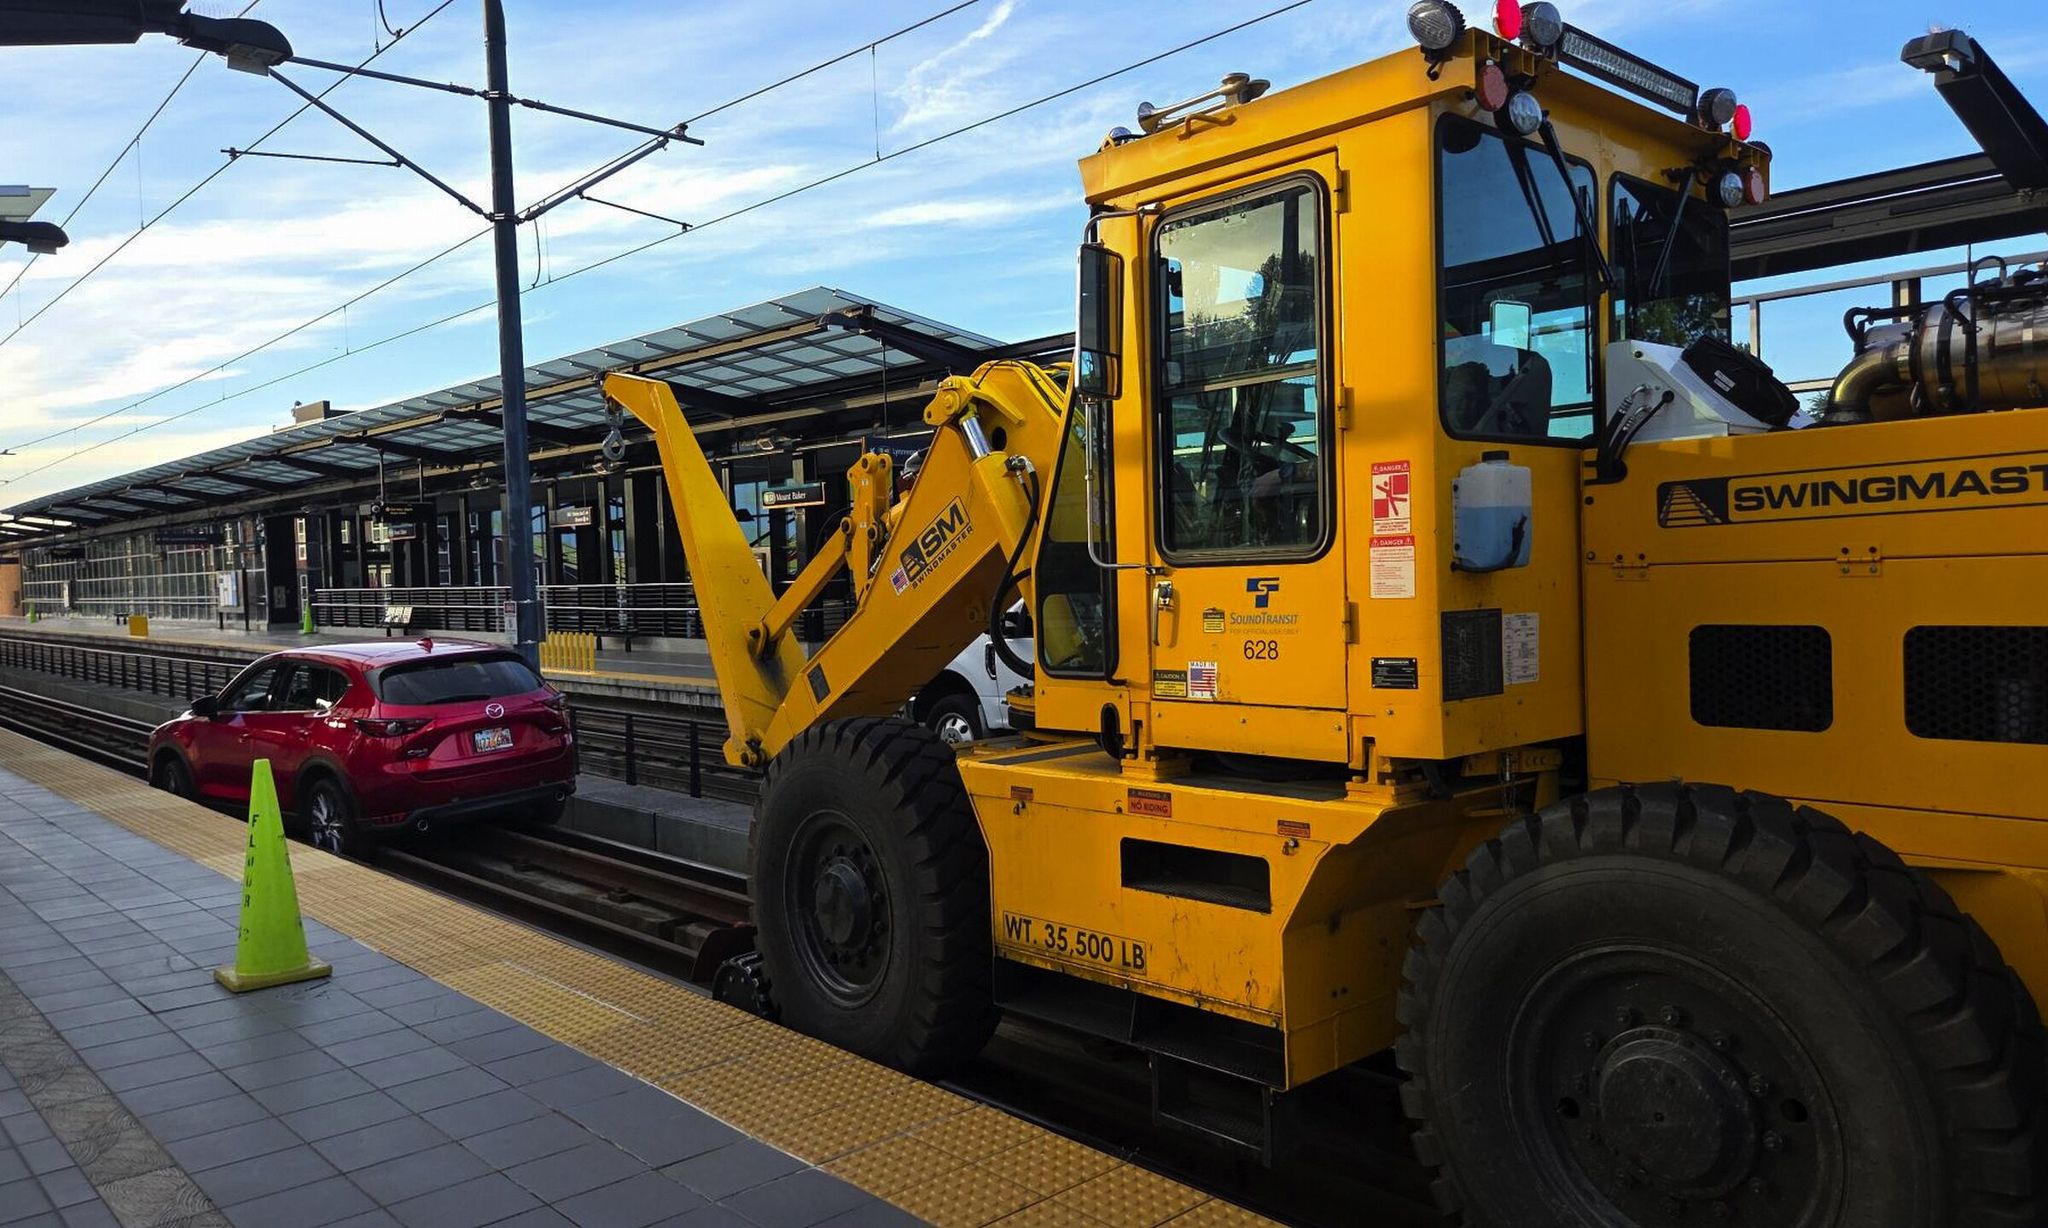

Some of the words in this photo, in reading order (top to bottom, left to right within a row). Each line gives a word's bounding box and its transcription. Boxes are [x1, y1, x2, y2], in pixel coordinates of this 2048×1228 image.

[1379, 538, 1404, 547] DANGER
[912, 526, 973, 589] SWINGMASTER
[1244, 640, 1279, 660] 628
[1130, 800, 1142, 811] NO
[1143, 802, 1168, 814] RIDING
[1005, 914, 1037, 945] WT.
[1045, 923, 1114, 962] 35,500
[1121, 941, 1145, 970] LB
